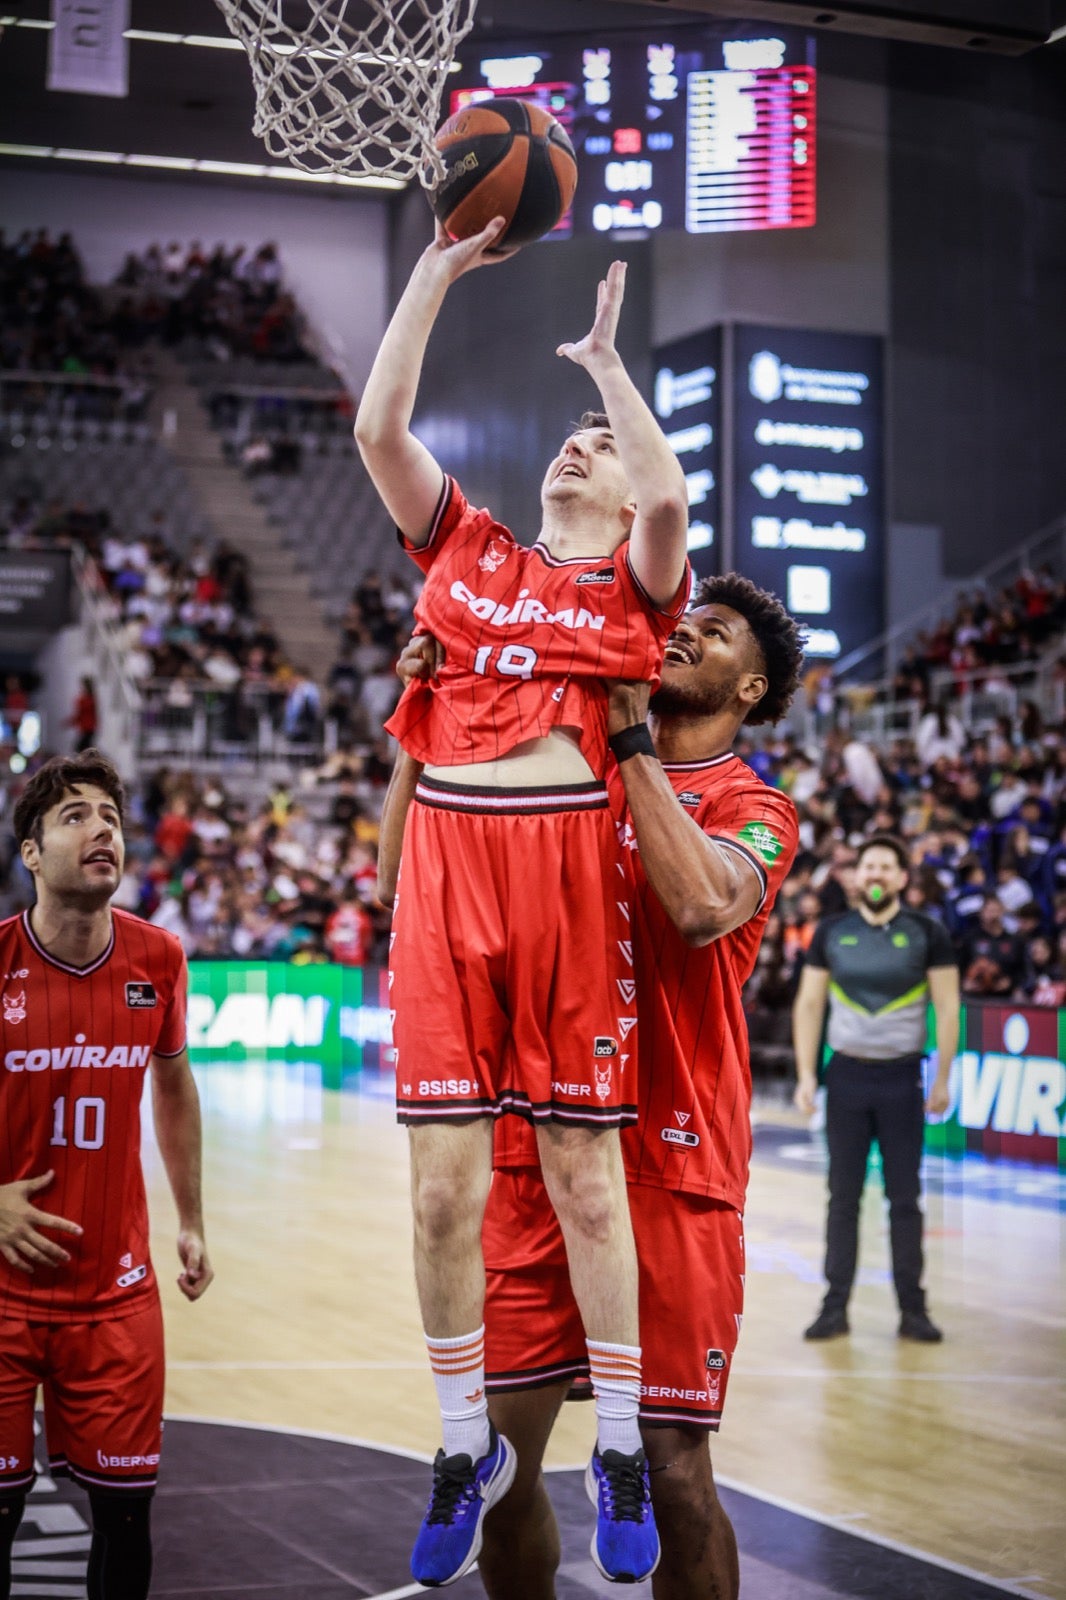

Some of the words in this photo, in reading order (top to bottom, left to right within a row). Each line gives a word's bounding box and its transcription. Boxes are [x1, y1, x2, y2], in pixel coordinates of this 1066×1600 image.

[450, 580, 605, 630] COVIRAN
[4, 1033, 150, 1072] COVIRAN
[597, 1046, 613, 1055] acb
[418, 1079, 471, 1096] asisa
[50, 1096, 106, 1150] 10
[708, 1358, 724, 1367] acb
[639, 1385, 708, 1402] BERNER
